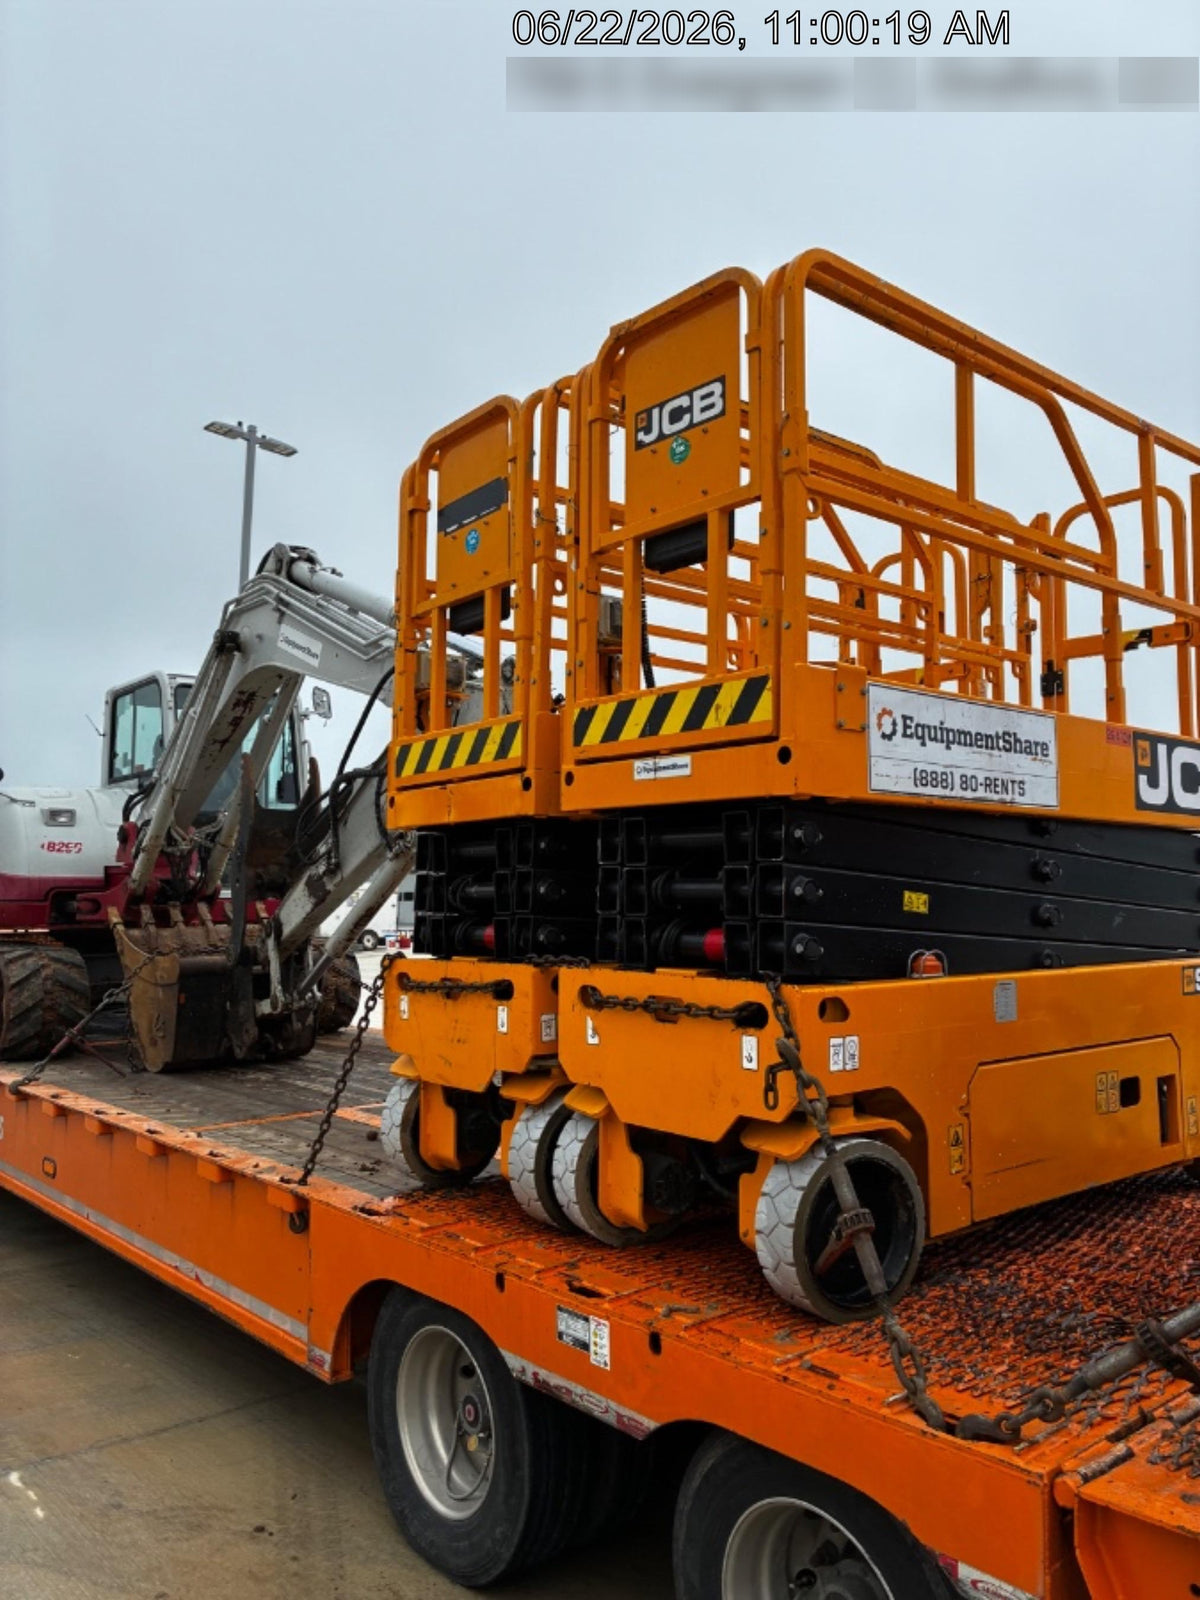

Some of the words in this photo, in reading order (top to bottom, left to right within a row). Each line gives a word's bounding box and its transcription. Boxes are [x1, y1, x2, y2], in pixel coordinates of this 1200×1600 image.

[636, 381, 724, 444] JCB
[900, 713, 1051, 758] EquipmentShare
[913, 767, 954, 791] (888)
[959, 773, 1026, 797] 80-RENTS
